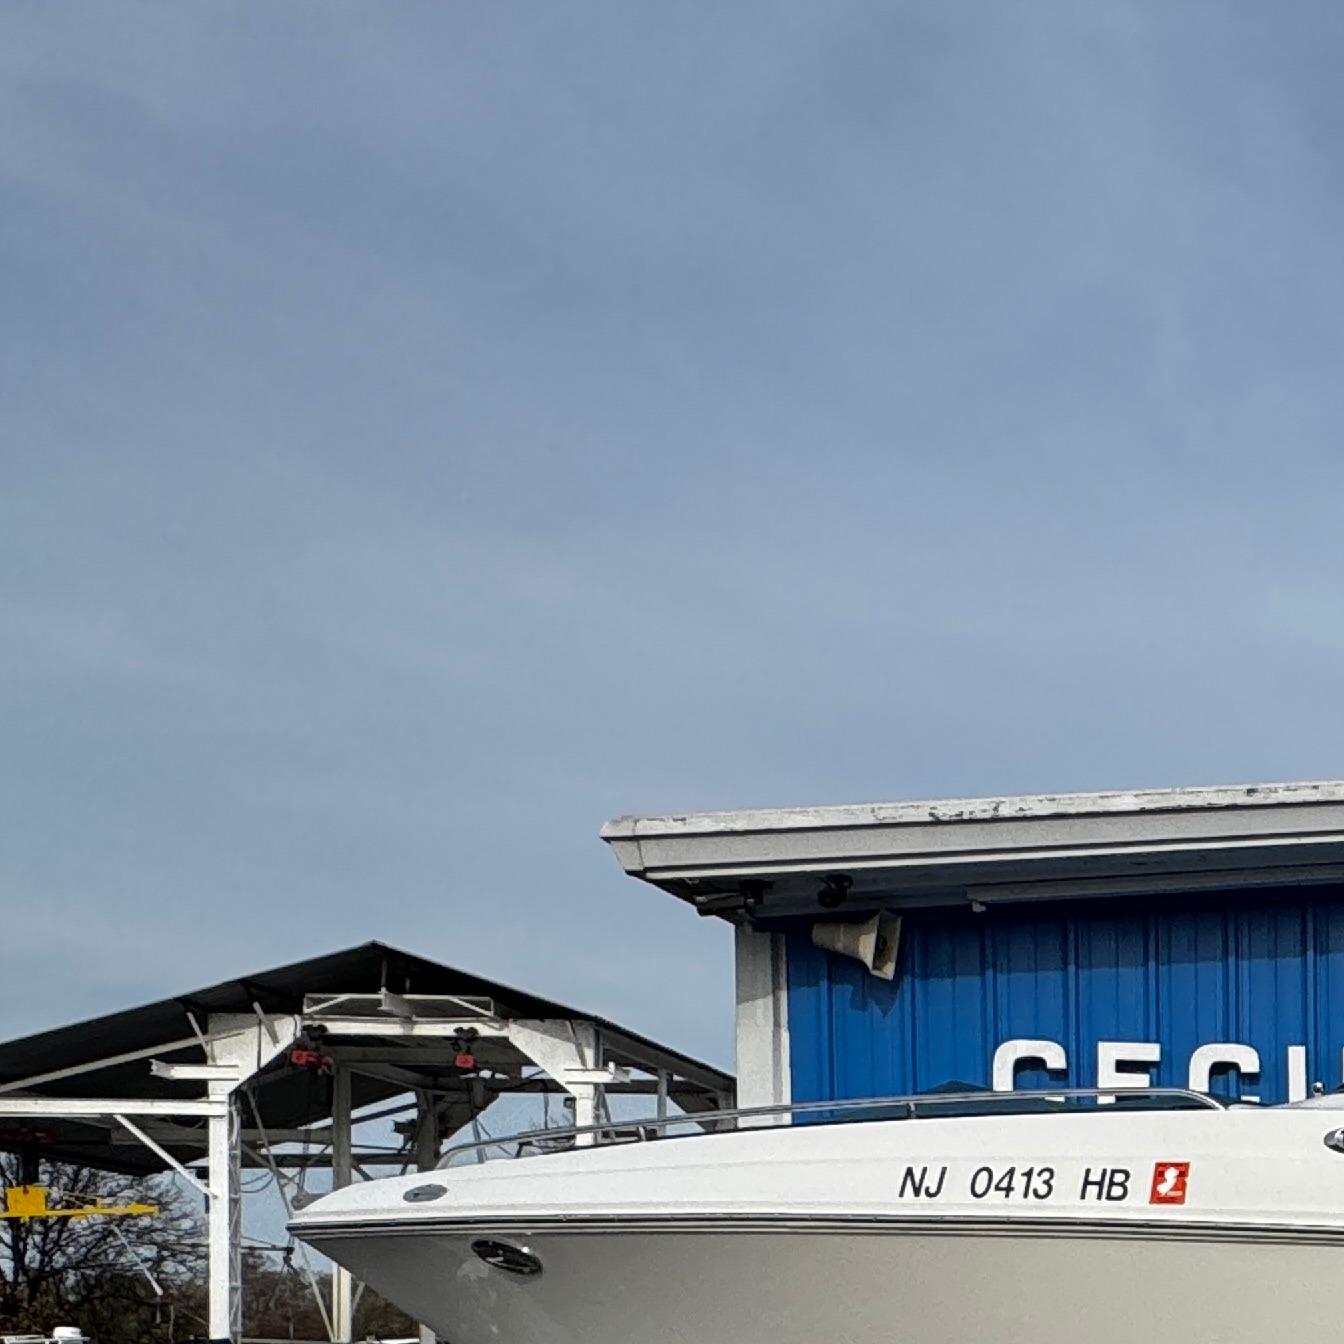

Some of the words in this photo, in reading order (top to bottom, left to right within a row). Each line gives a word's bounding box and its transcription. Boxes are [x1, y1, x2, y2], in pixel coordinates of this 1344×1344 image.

[898, 1166, 948, 1199] NJ
[969, 1166, 1056, 1200] 0413
[1079, 1167, 1131, 1202] HB
